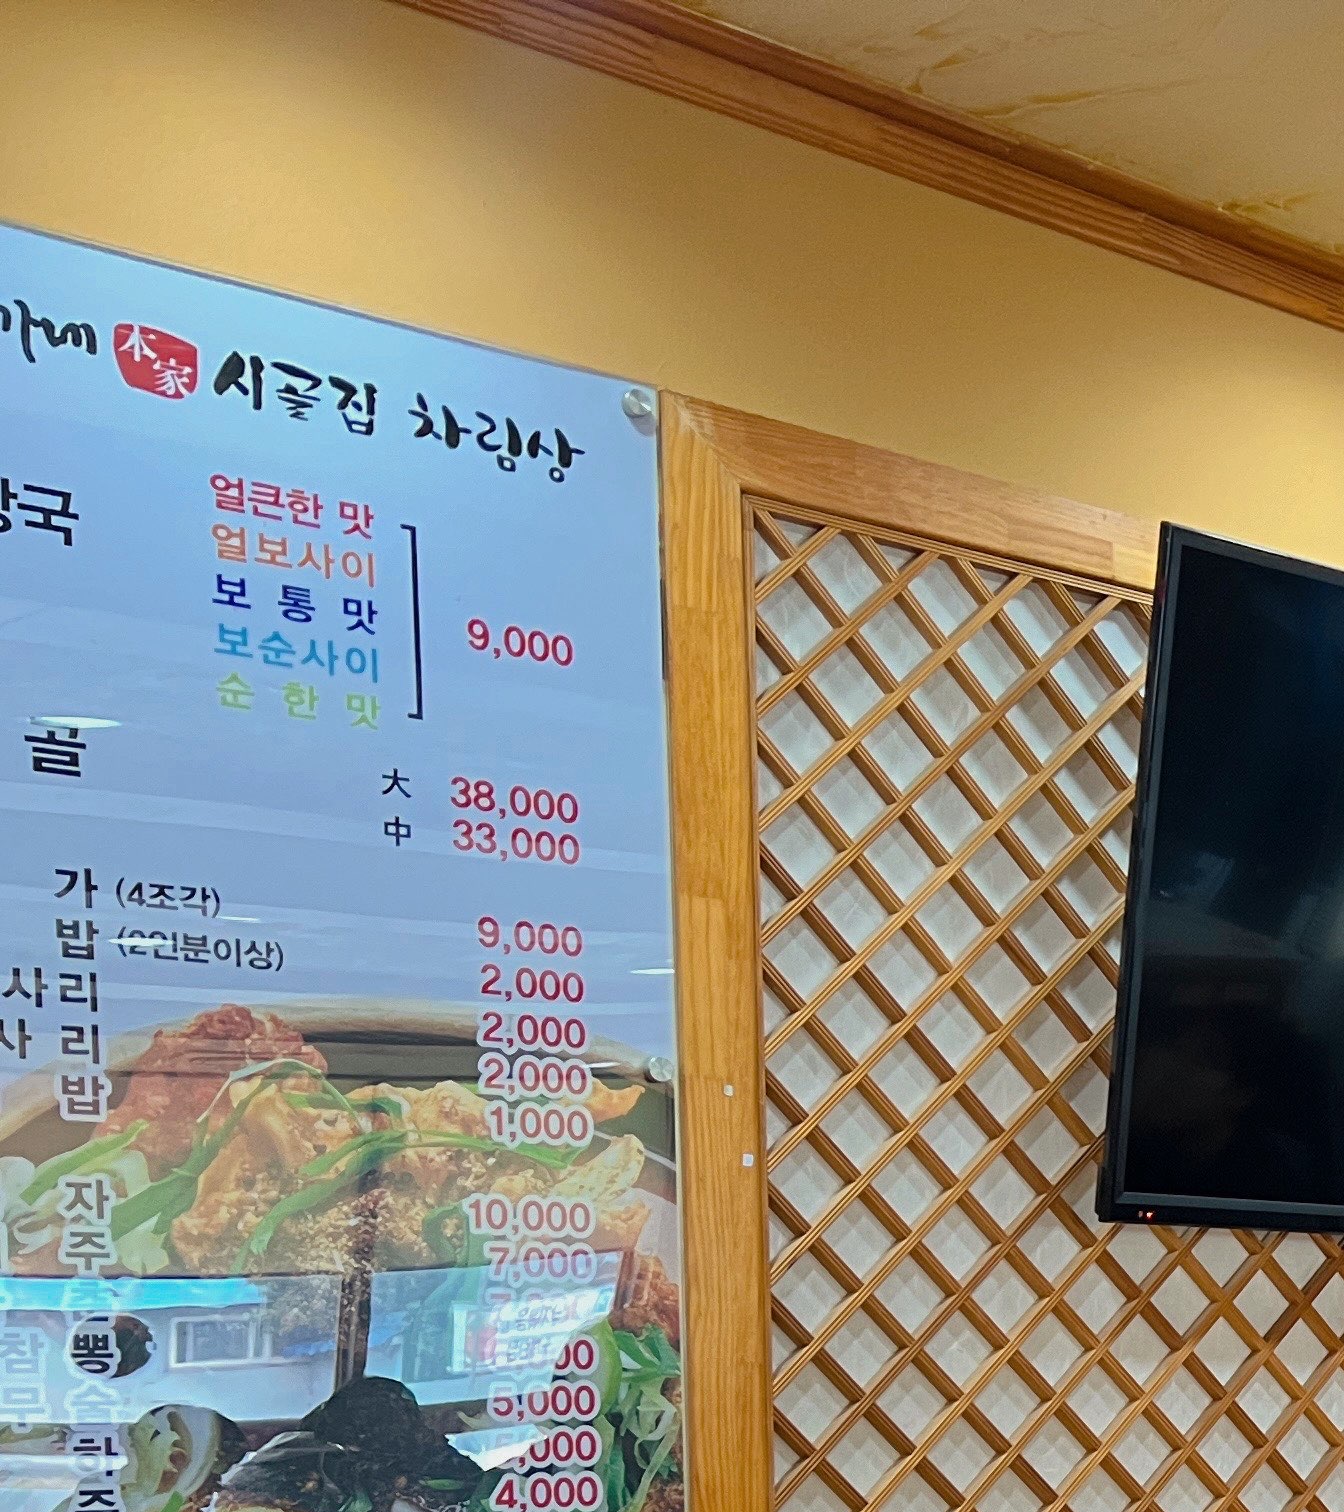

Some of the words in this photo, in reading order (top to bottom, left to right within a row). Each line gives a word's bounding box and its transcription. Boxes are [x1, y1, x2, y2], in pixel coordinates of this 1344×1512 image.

[213, 350, 378, 436] 시골집
[408, 393, 586, 483] 차림상
[210, 473, 323, 529] 얼큰한
[338, 501, 374, 539] 맛
[211, 523, 375, 587] 얼보사이
[342, 598, 378, 635] 맛
[214, 622, 379, 684] 보순사이
[467, 618, 574, 666] 9,000
[381, 768, 411, 798] 大
[450, 776, 579, 824] 38,000
[384, 816, 411, 846] 中
[452, 819, 580, 865] 33,000
[115, 877, 220, 918] (4조각)
[116, 926, 284, 971] (2인분이상)
[477, 916, 582, 957] 9,000
[481, 963, 584, 1003] 2,000
[482, 1011, 586, 1049] 2,000
[484, 1057, 587, 1095] 2,000
[490, 1106, 588, 1142] 1,000
[65, 1179, 109, 1219] 자
[468, 1199, 591, 1235] 10,000
[65, 1231, 111, 1271] 주
[489, 1247, 592, 1282] 7,000
[492, 1386, 596, 1421] 5,000
[495, 1477, 598, 1512] 4,000
